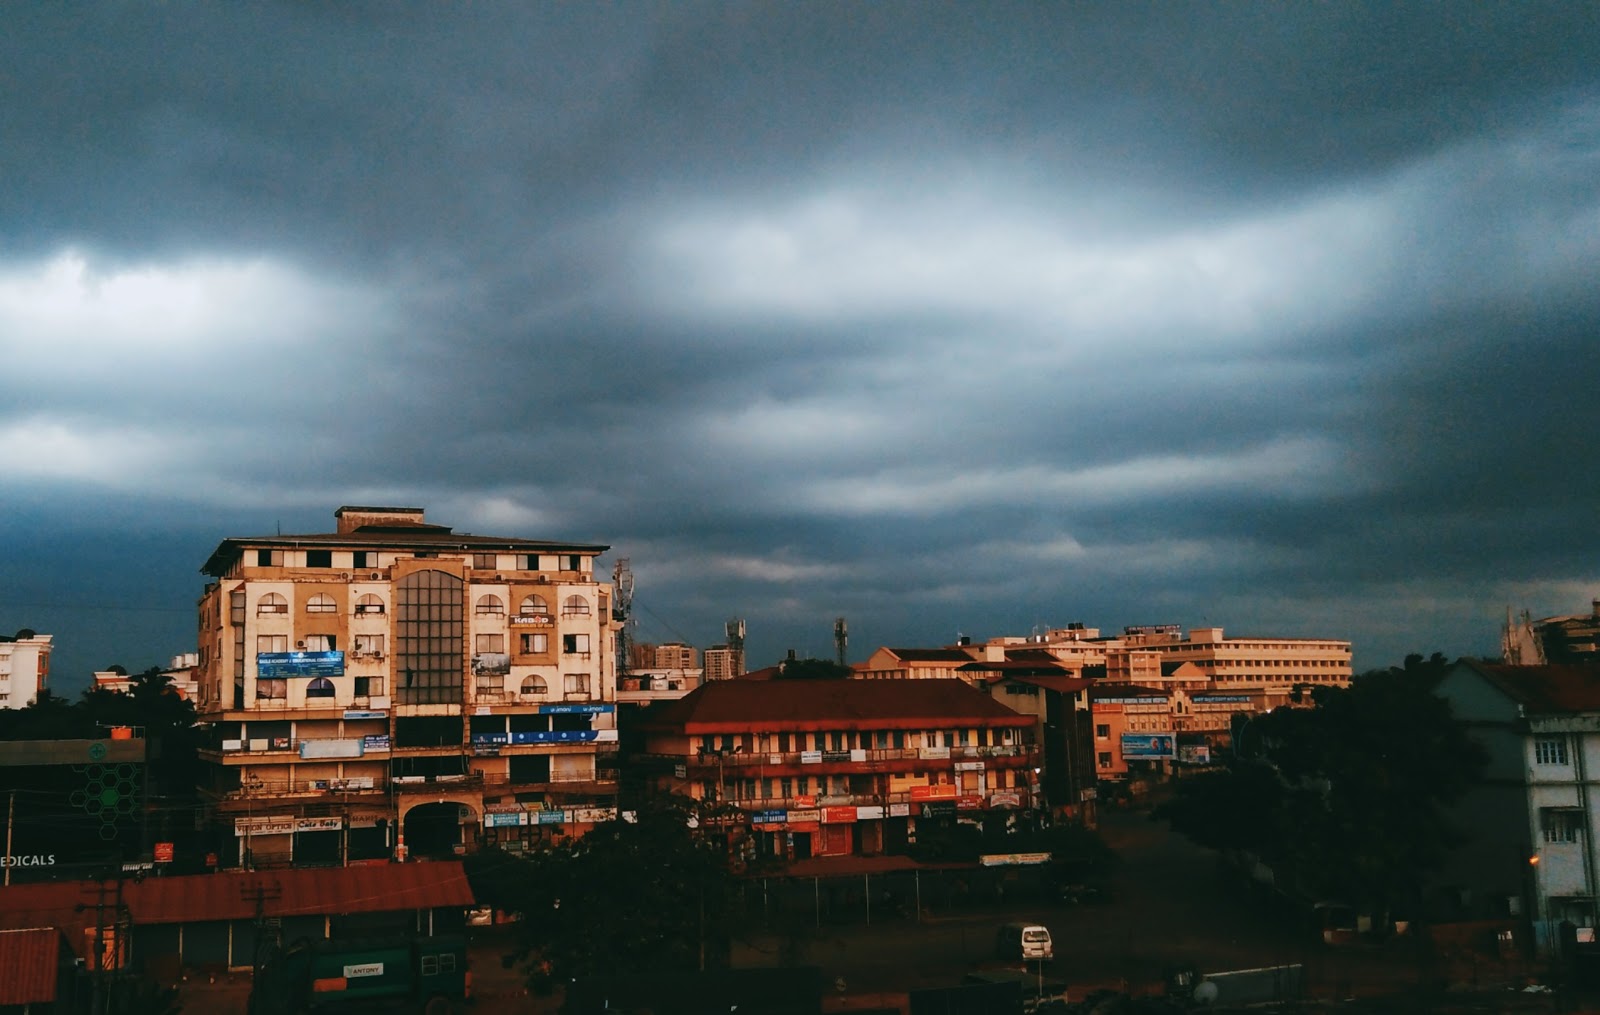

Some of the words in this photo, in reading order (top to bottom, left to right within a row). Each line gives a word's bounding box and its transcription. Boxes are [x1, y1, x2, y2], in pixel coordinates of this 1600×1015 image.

[266, 823, 292, 831] OPTICS
[320, 819, 339, 828] Baby
[0, 854, 55, 868] EDICALS
